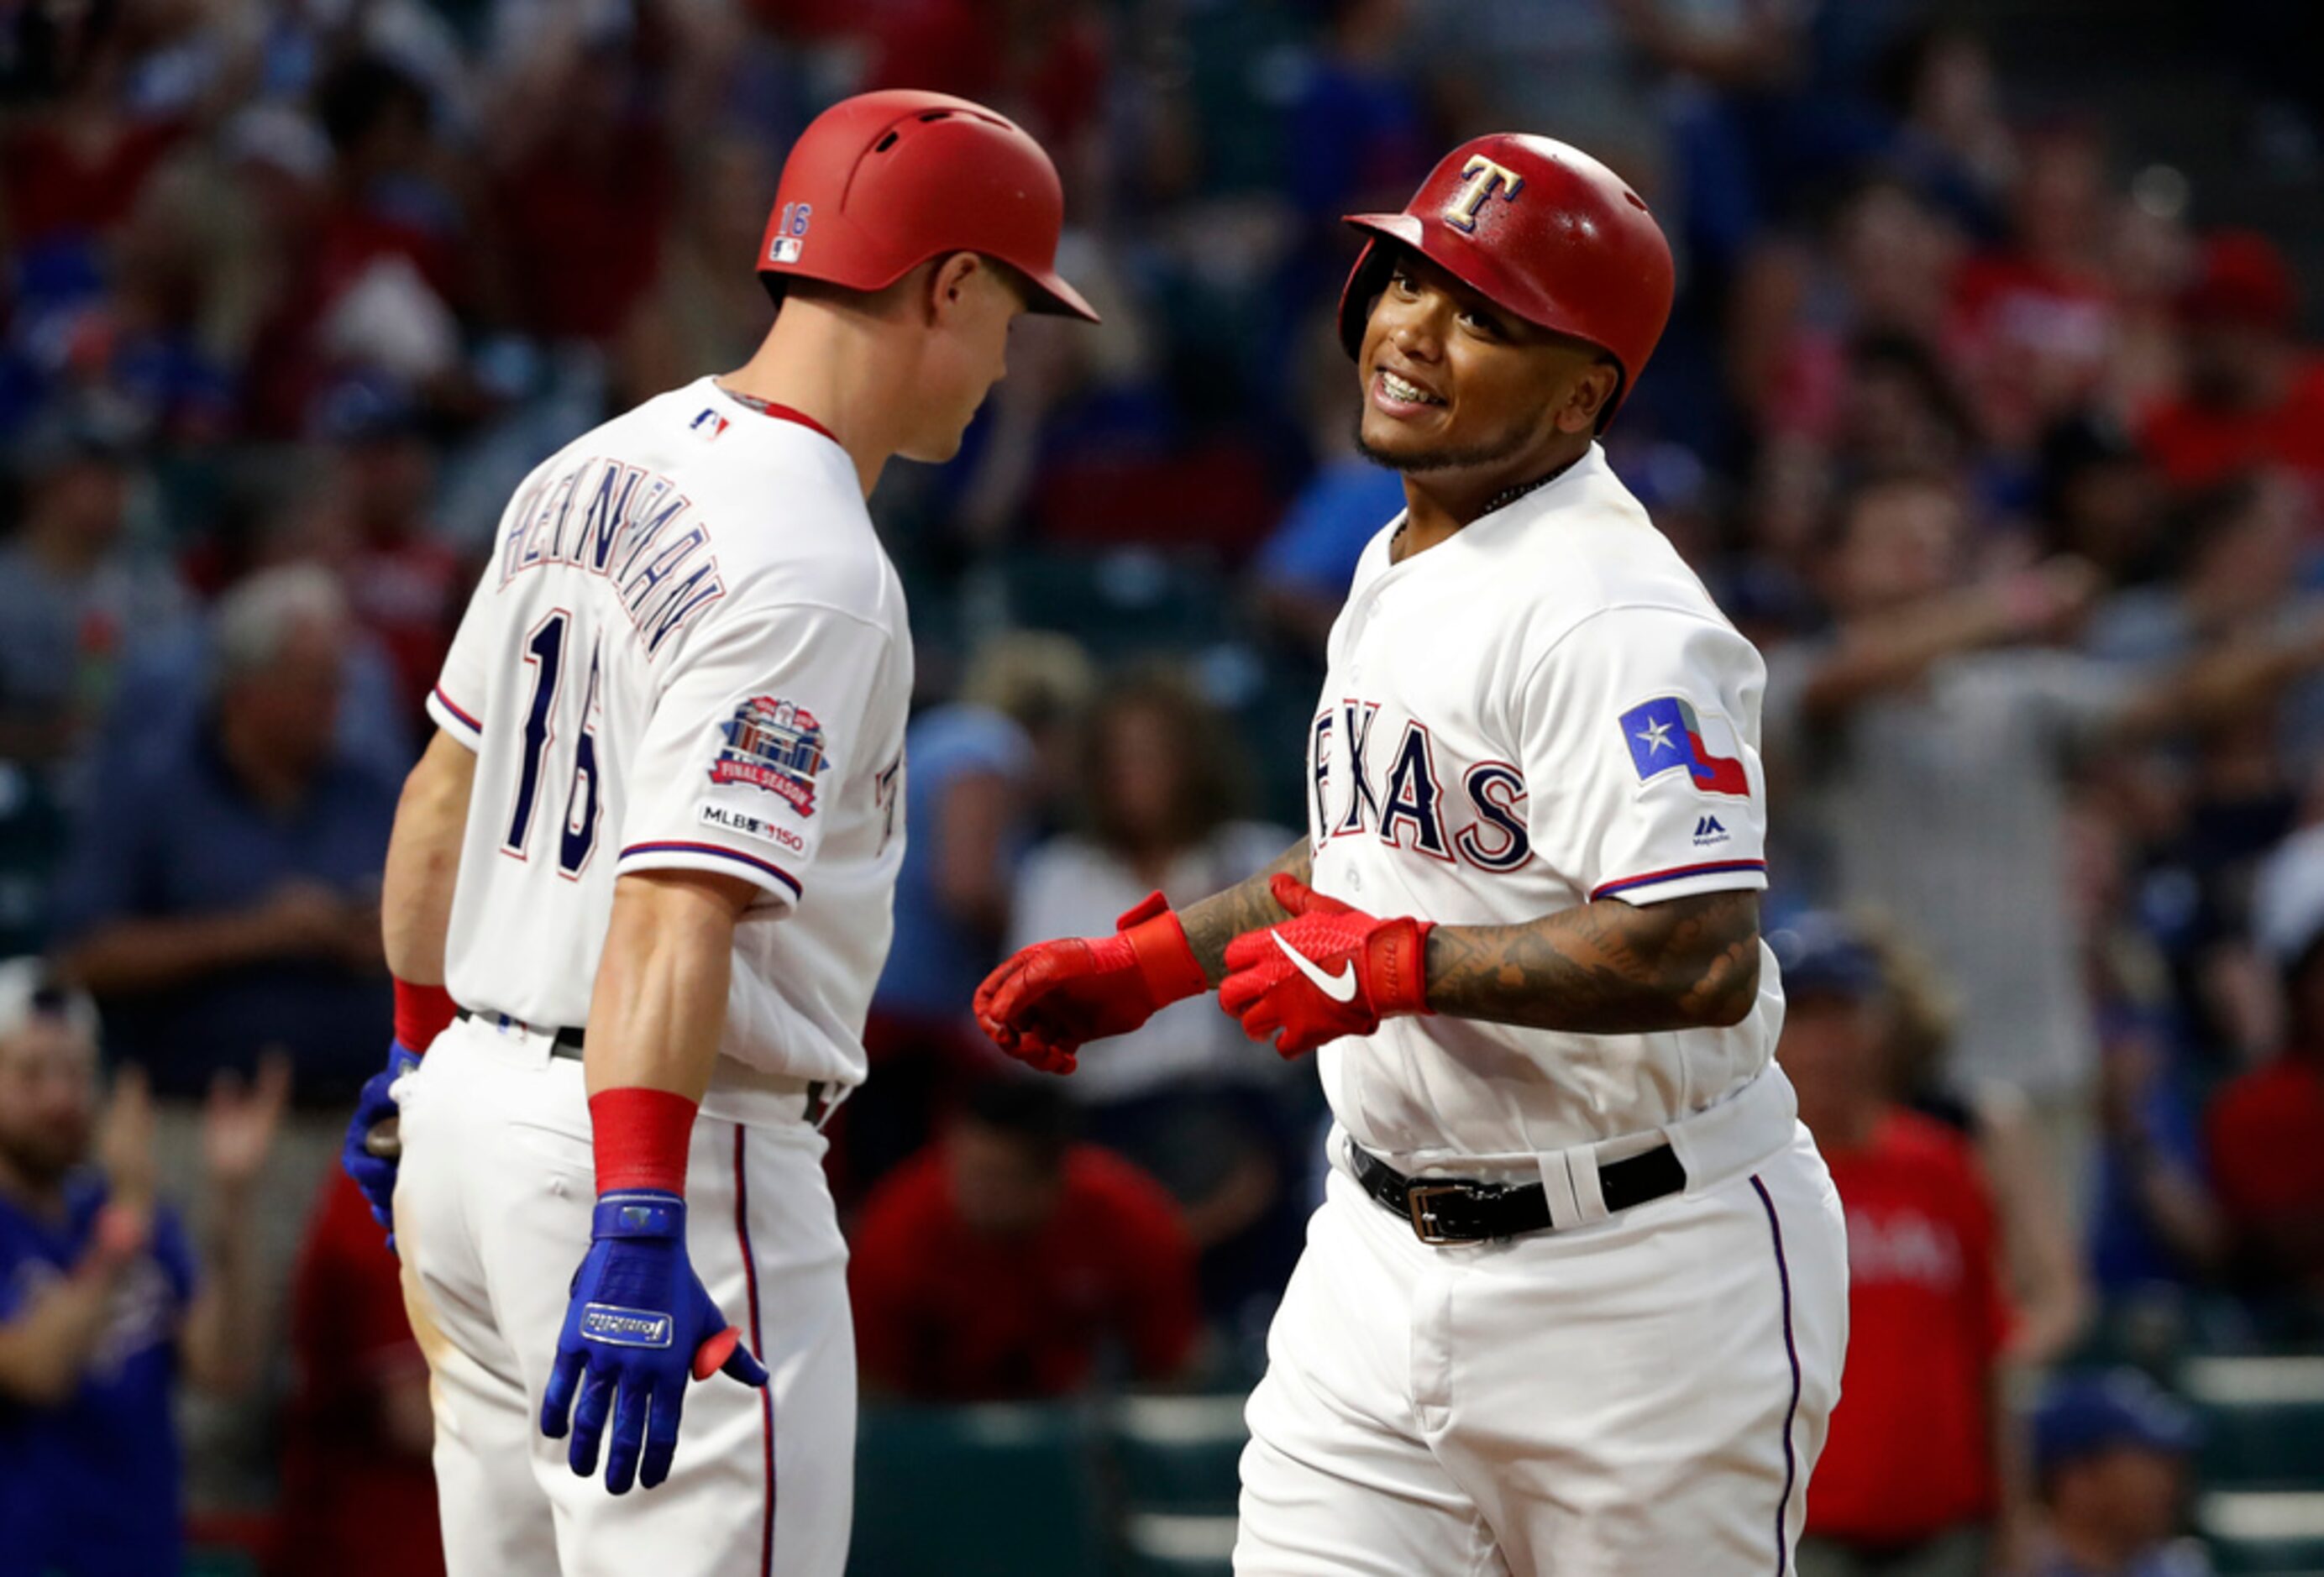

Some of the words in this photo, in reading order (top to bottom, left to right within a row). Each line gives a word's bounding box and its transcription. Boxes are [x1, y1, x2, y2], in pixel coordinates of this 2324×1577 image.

[1445, 154, 1525, 233] T
[778, 202, 812, 237] 16
[721, 761, 758, 781] FINAL
[760, 770, 809, 806] SEASON
[1306, 698, 1535, 873] EXAS
[703, 805, 747, 829] MLB
